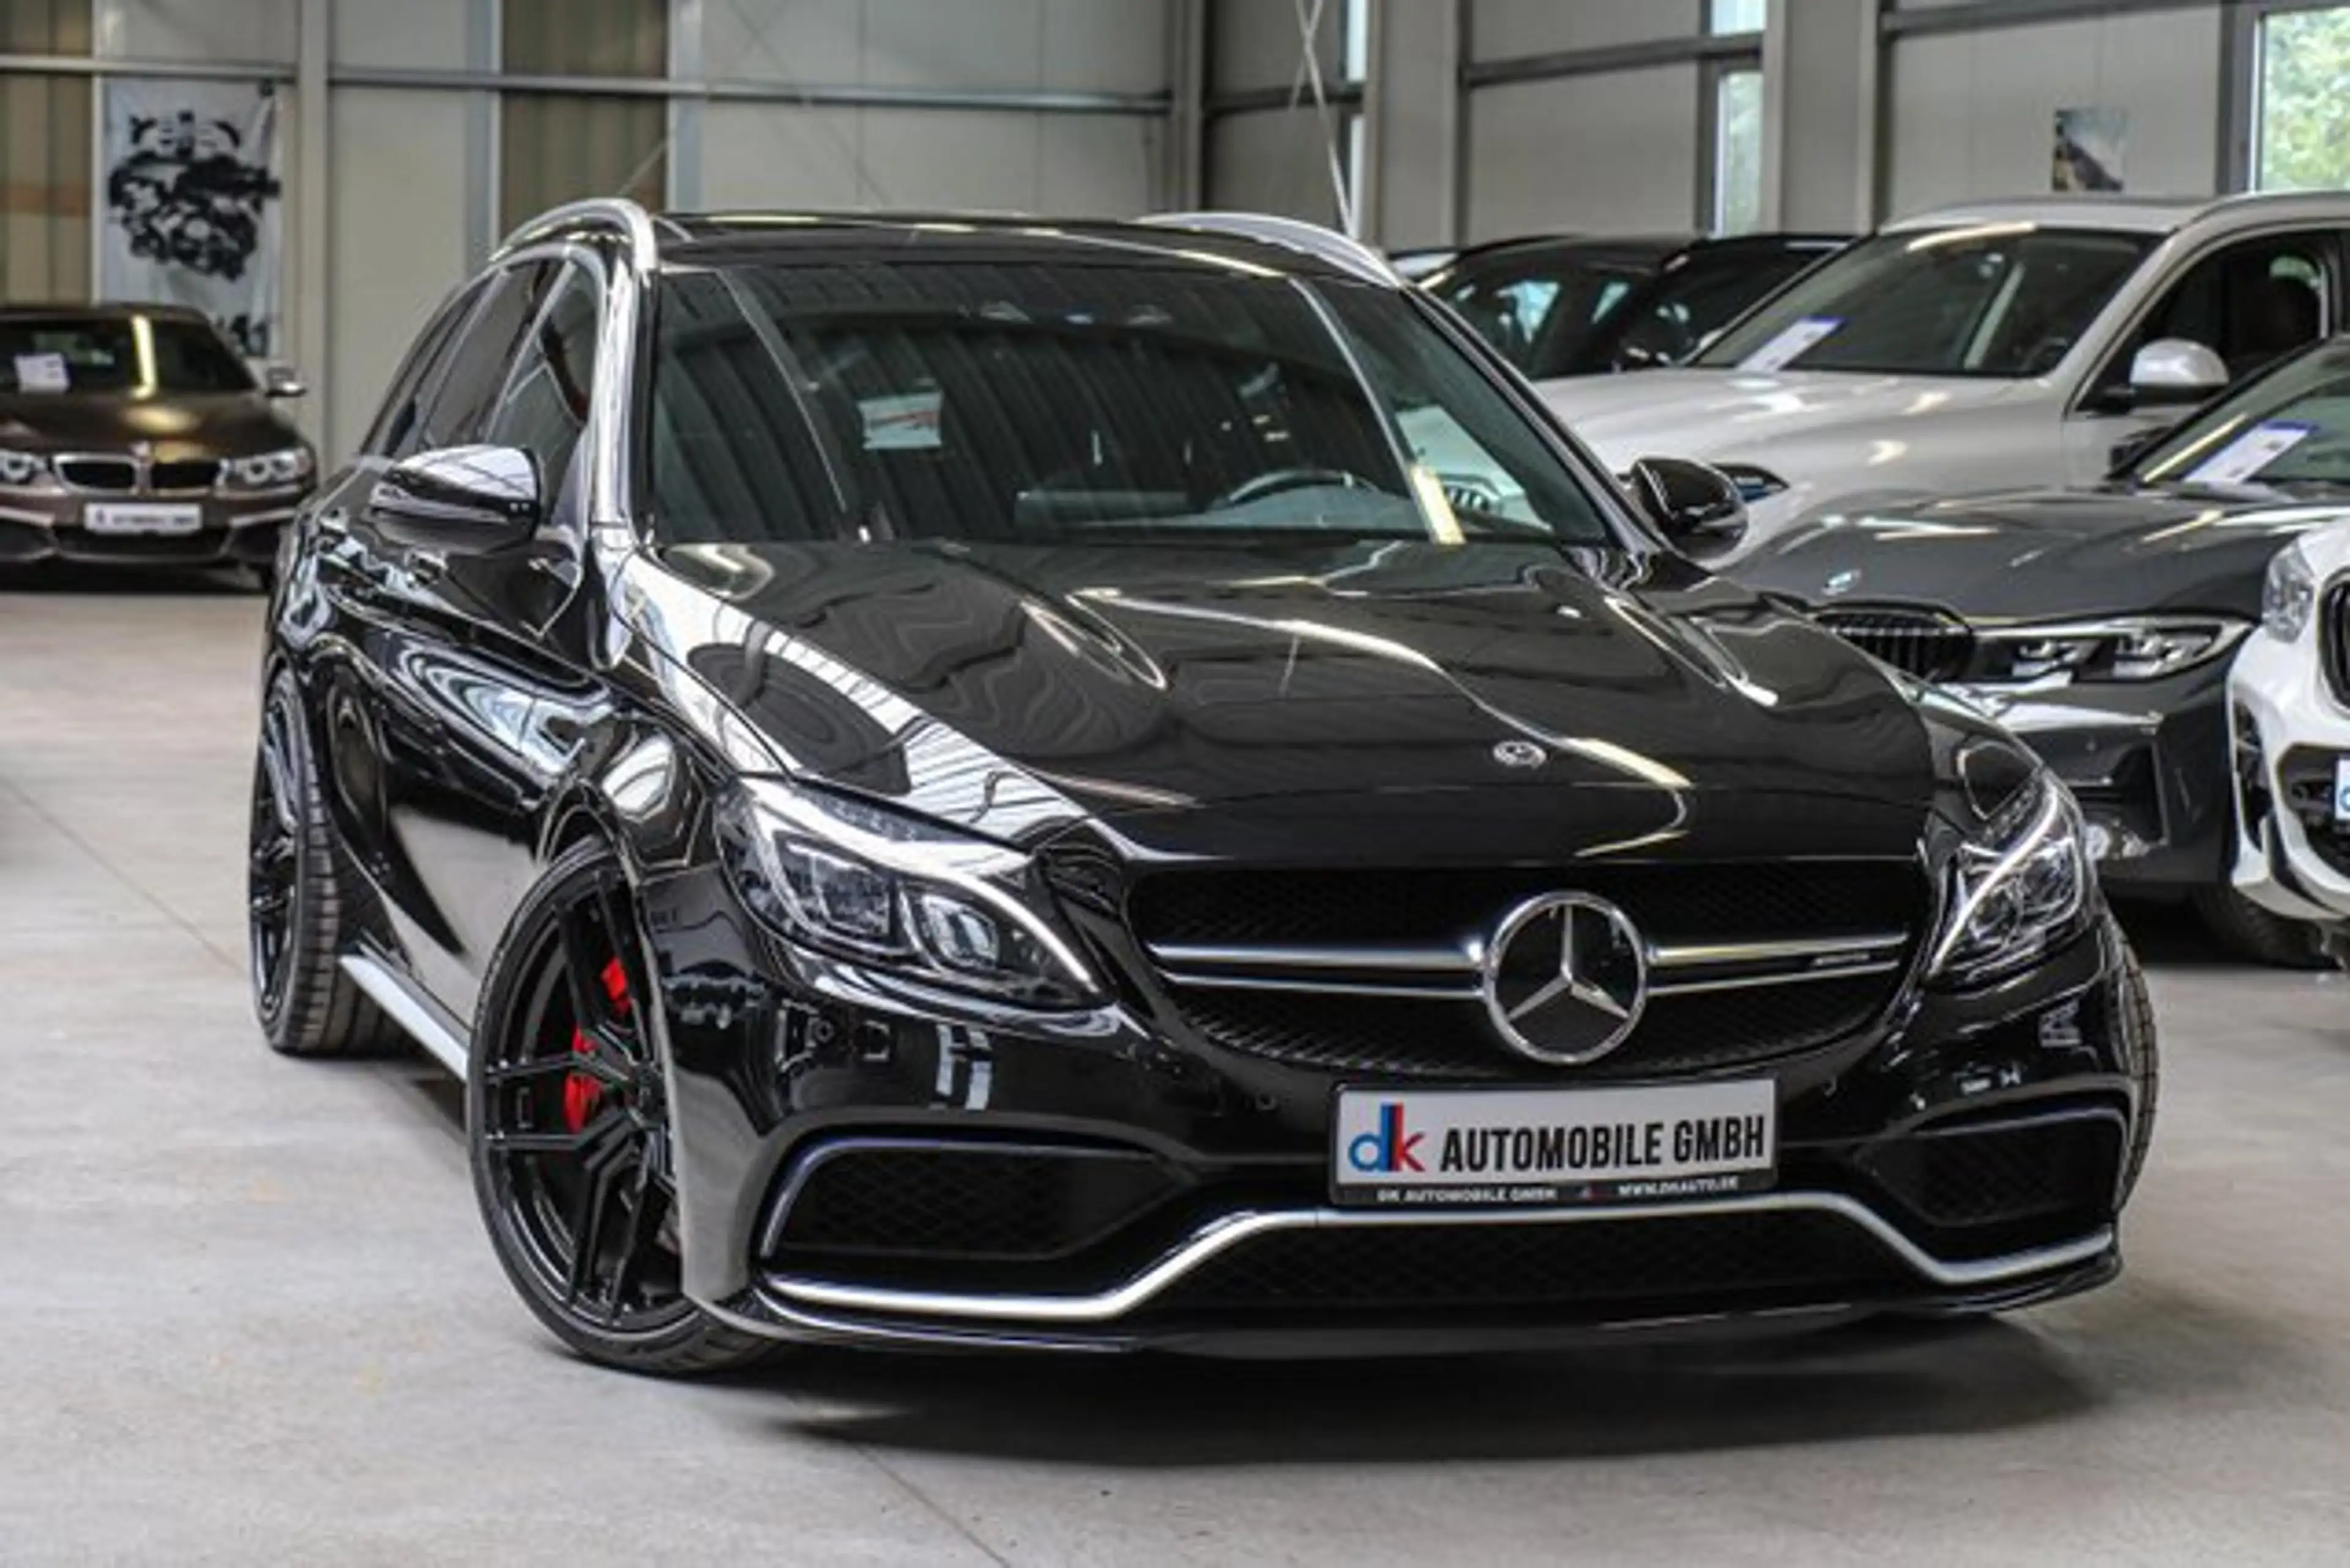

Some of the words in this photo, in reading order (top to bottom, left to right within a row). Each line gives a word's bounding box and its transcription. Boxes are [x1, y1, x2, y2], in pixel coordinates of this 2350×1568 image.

[1348, 1103, 1425, 1172] dk
[1439, 1122, 1664, 1173] AUTOMOBILE
[1674, 1114, 1764, 1164] GMBH
[1404, 1187, 1508, 1203] AUTOMOBILE
